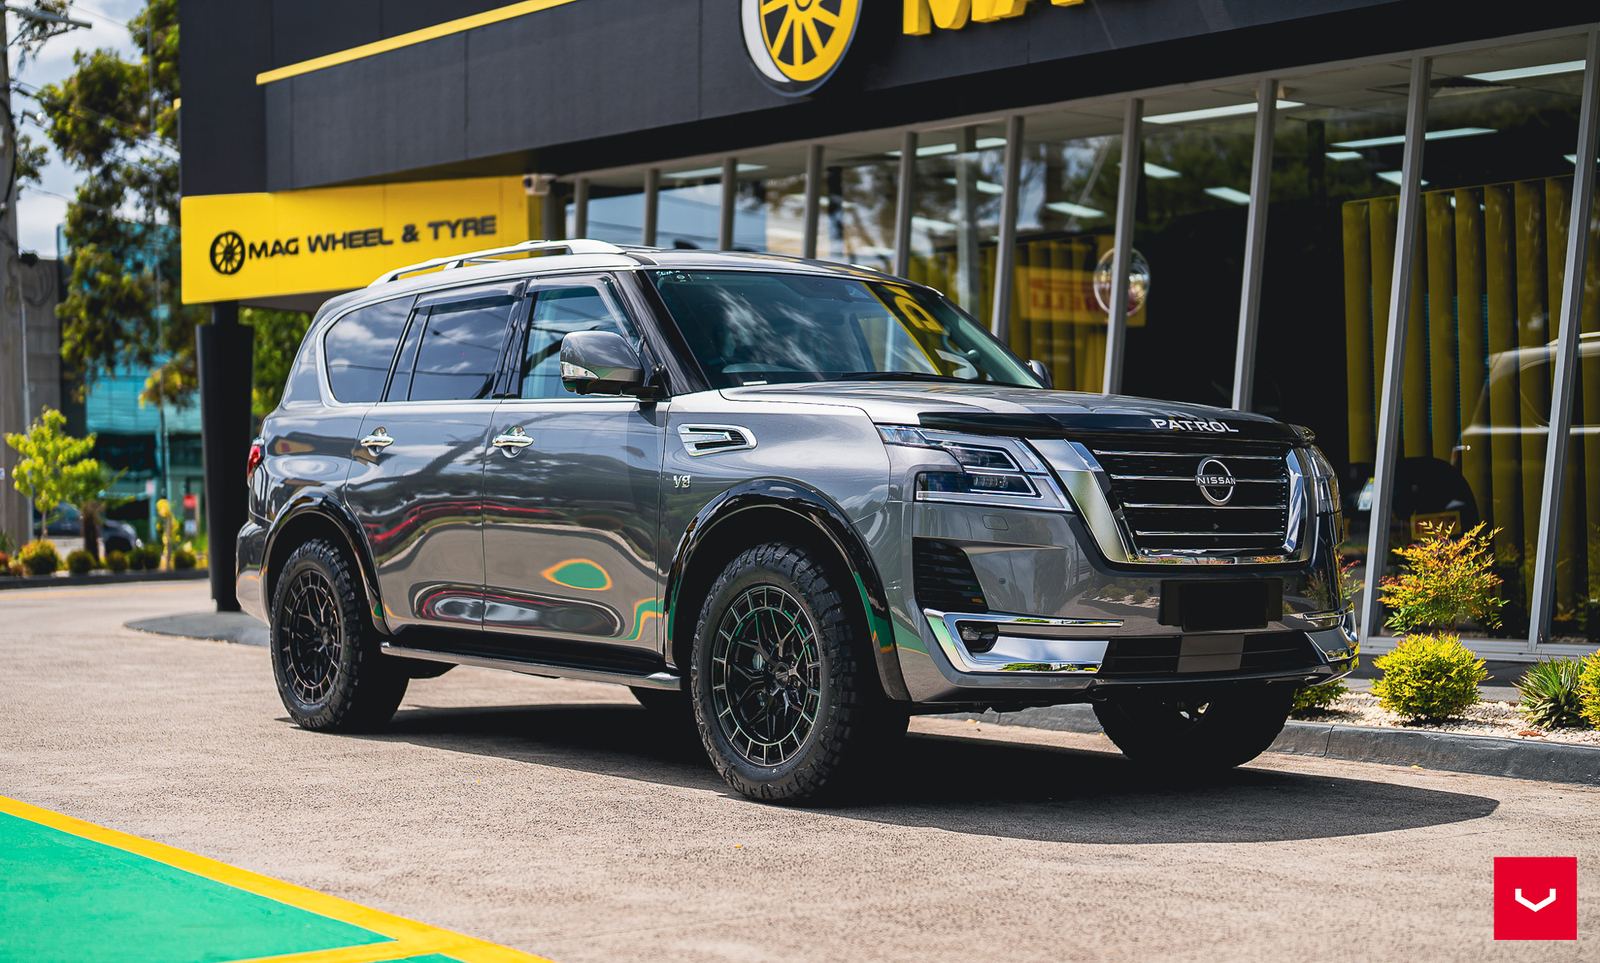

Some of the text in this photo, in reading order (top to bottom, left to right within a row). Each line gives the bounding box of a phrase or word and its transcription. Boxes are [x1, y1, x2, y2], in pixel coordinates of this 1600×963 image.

[249, 215, 497, 260] MAG WHEEL & TYRE
[1150, 418, 1239, 433] PATROL
[1197, 476, 1236, 485] NISSAN
